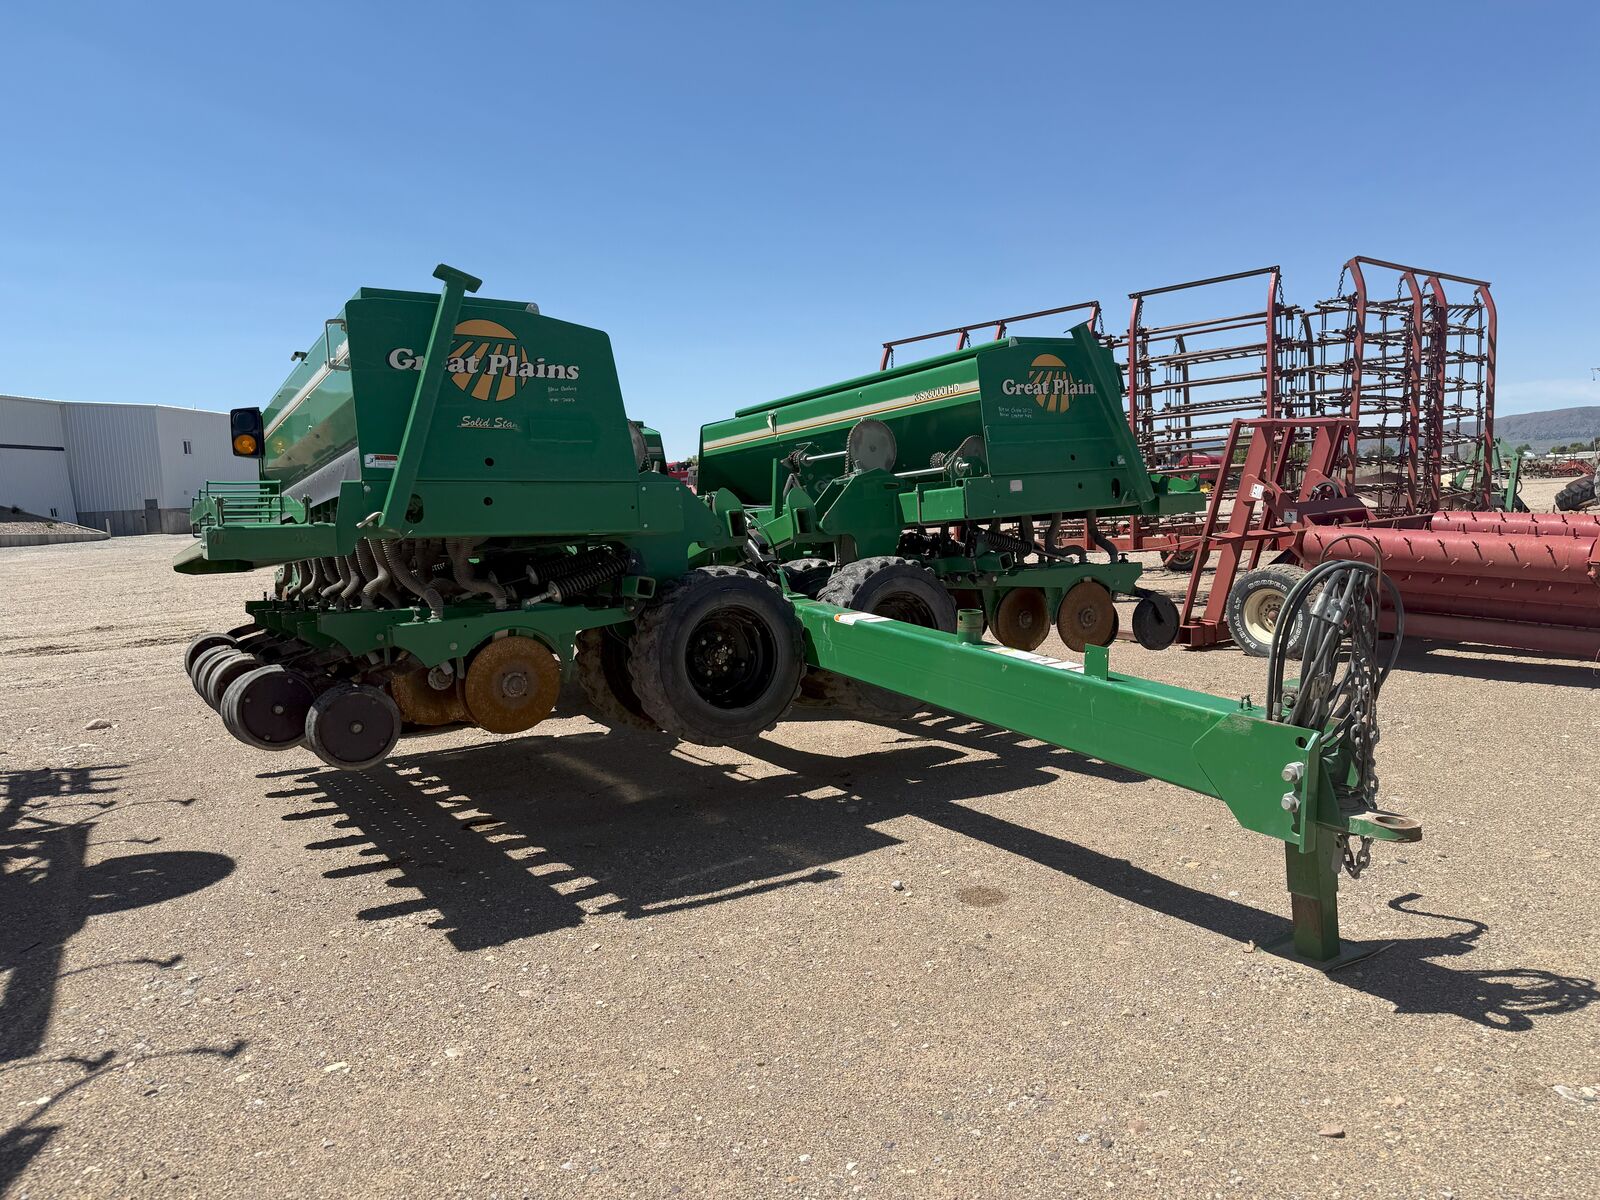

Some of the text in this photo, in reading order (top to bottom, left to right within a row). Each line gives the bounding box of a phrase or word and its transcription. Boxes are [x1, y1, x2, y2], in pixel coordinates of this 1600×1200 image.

[387, 347, 580, 380] Grat Plains
[1002, 379, 1097, 395] Great Plain
[461, 415, 491, 428] Solid
